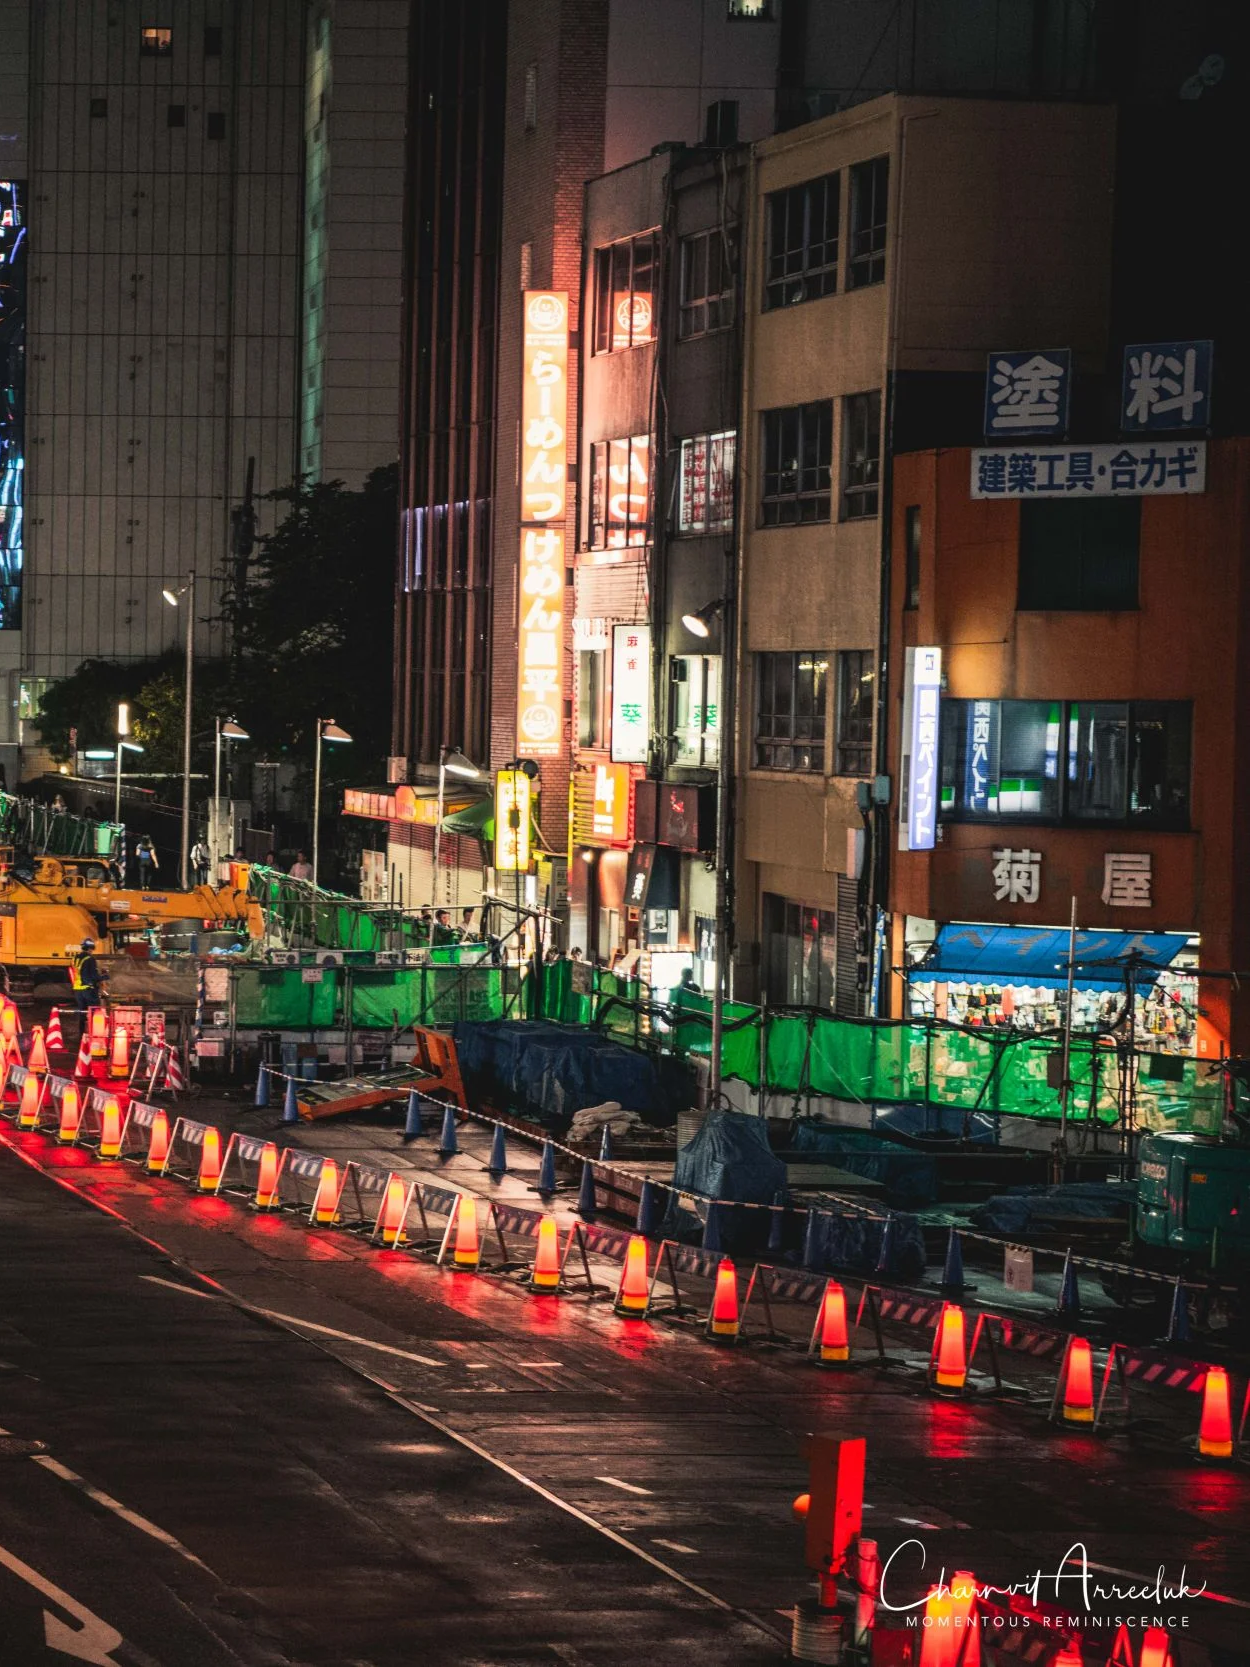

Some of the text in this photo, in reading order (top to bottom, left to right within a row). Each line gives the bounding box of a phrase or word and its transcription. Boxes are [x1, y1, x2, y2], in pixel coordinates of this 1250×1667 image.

[992, 349, 1204, 428] 塗料
[978, 447, 1199, 493] 建築工具・合カギ
[627, 636, 639, 671] 麻雀
[915, 689, 937, 844] 関西ペイント
[992, 849, 1153, 908] 菊屋
[947, 927, 1160, 957] ペイント
